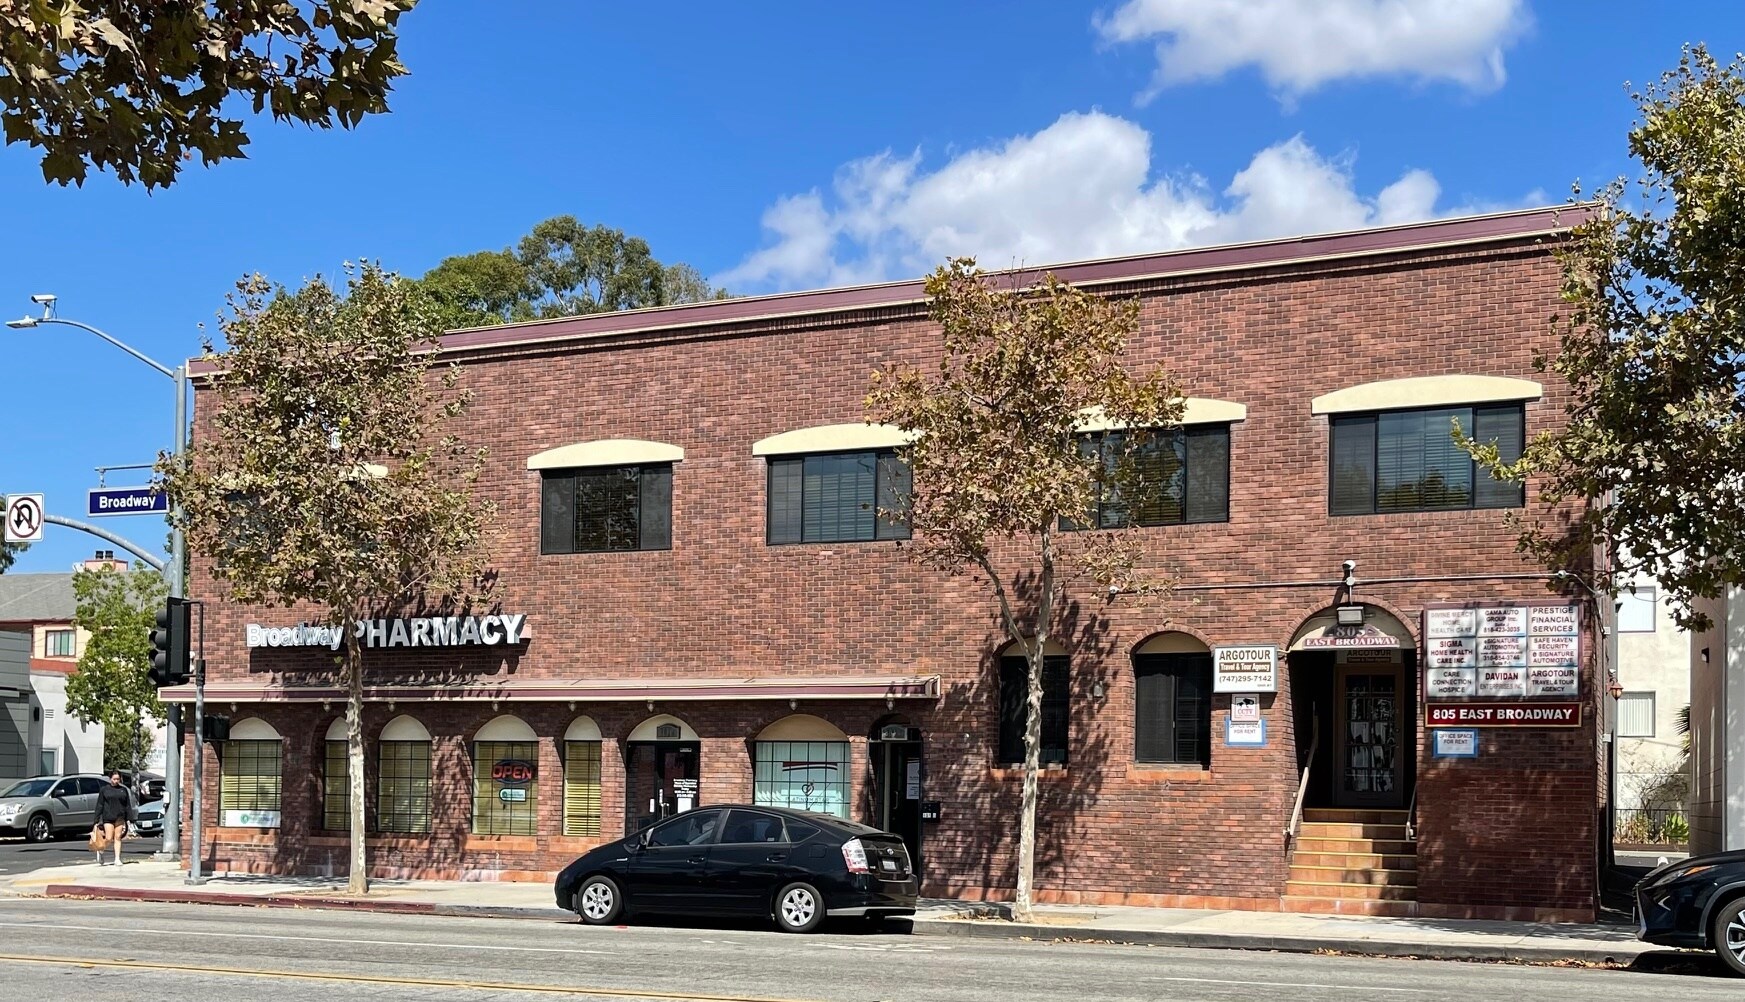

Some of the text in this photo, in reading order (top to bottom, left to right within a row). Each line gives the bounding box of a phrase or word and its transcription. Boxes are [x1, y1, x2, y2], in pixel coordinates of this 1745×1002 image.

[99, 494, 156, 509] Broadway
[247, 622, 343, 651] Broadway
[1306, 637, 1396, 646] EAST BROADWAY
[1440, 640, 1463, 648] SIGMA
[1219, 649, 1271, 660] ARGOTOUR
[1220, 662, 1270, 672] Travel & Tour Agency
[1485, 672, 1519, 680] DAVIDAN
[1531, 669, 1575, 677] ARGOTOUR
[1219, 675, 1272, 683] (747)295-7142
[1433, 709, 1573, 719] 805 EAST BROADWAY
[492, 765, 532, 780] OPEN
